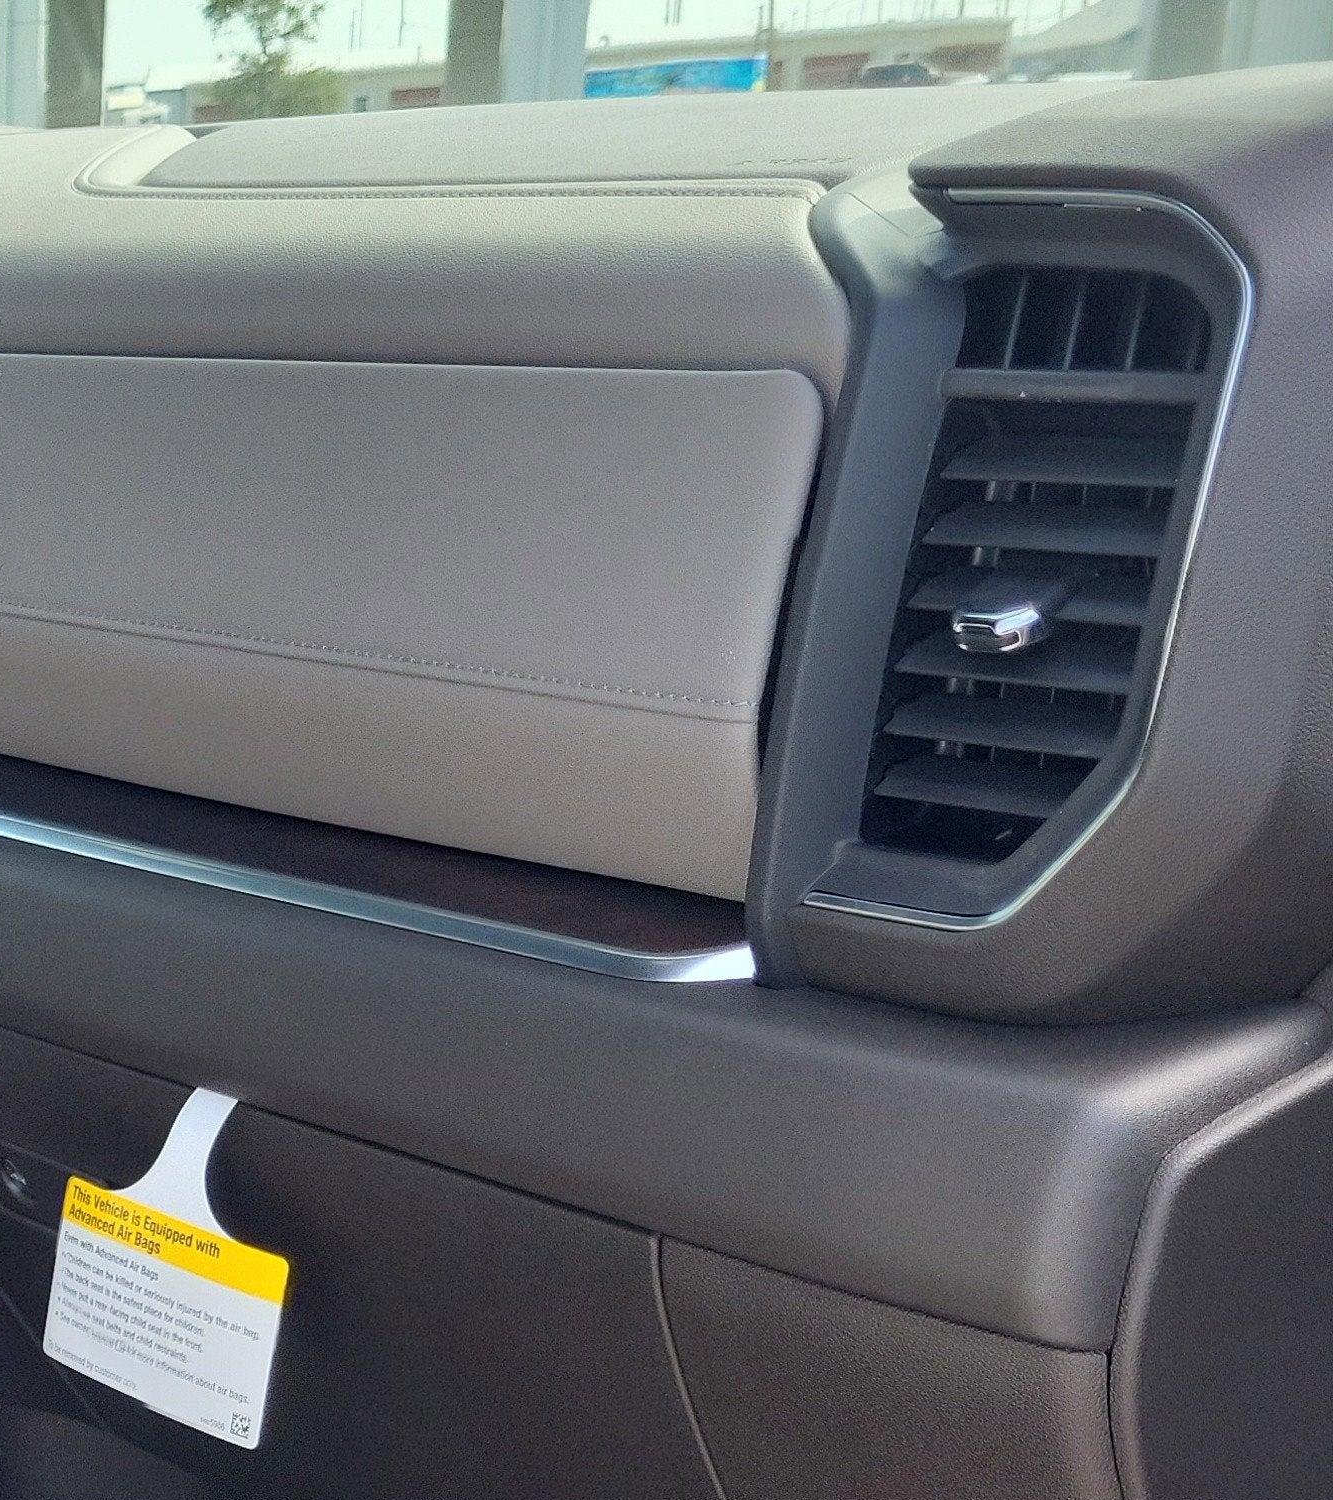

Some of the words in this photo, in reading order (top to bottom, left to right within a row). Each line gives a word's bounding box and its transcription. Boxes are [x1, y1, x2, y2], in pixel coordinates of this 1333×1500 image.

[68, 1203, 115, 1235] Advanced
[116, 1225, 133, 1242] Air
[134, 1231, 161, 1255] Bags
[73, 1185, 91, 1205] This
[94, 1194, 129, 1222] Vehicle
[131, 1210, 141, 1227] is
[143, 1215, 194, 1248] Equipped
[196, 1239, 220, 1258] with
[64, 1231, 79, 1245] Even
[80, 1241, 94, 1252] with
[94, 1246, 129, 1268] Advanced
[140, 1265, 159, 1281] Bags
[143, 1288, 175, 1309] seriously
[176, 1300, 202, 1319] injured
[143, 1305, 163, 1319] place
[130, 1316, 147, 1329] child
[136, 1335, 153, 1348] child
[195, 1377, 216, 1392] about
[228, 1388, 249, 1404] bags.
